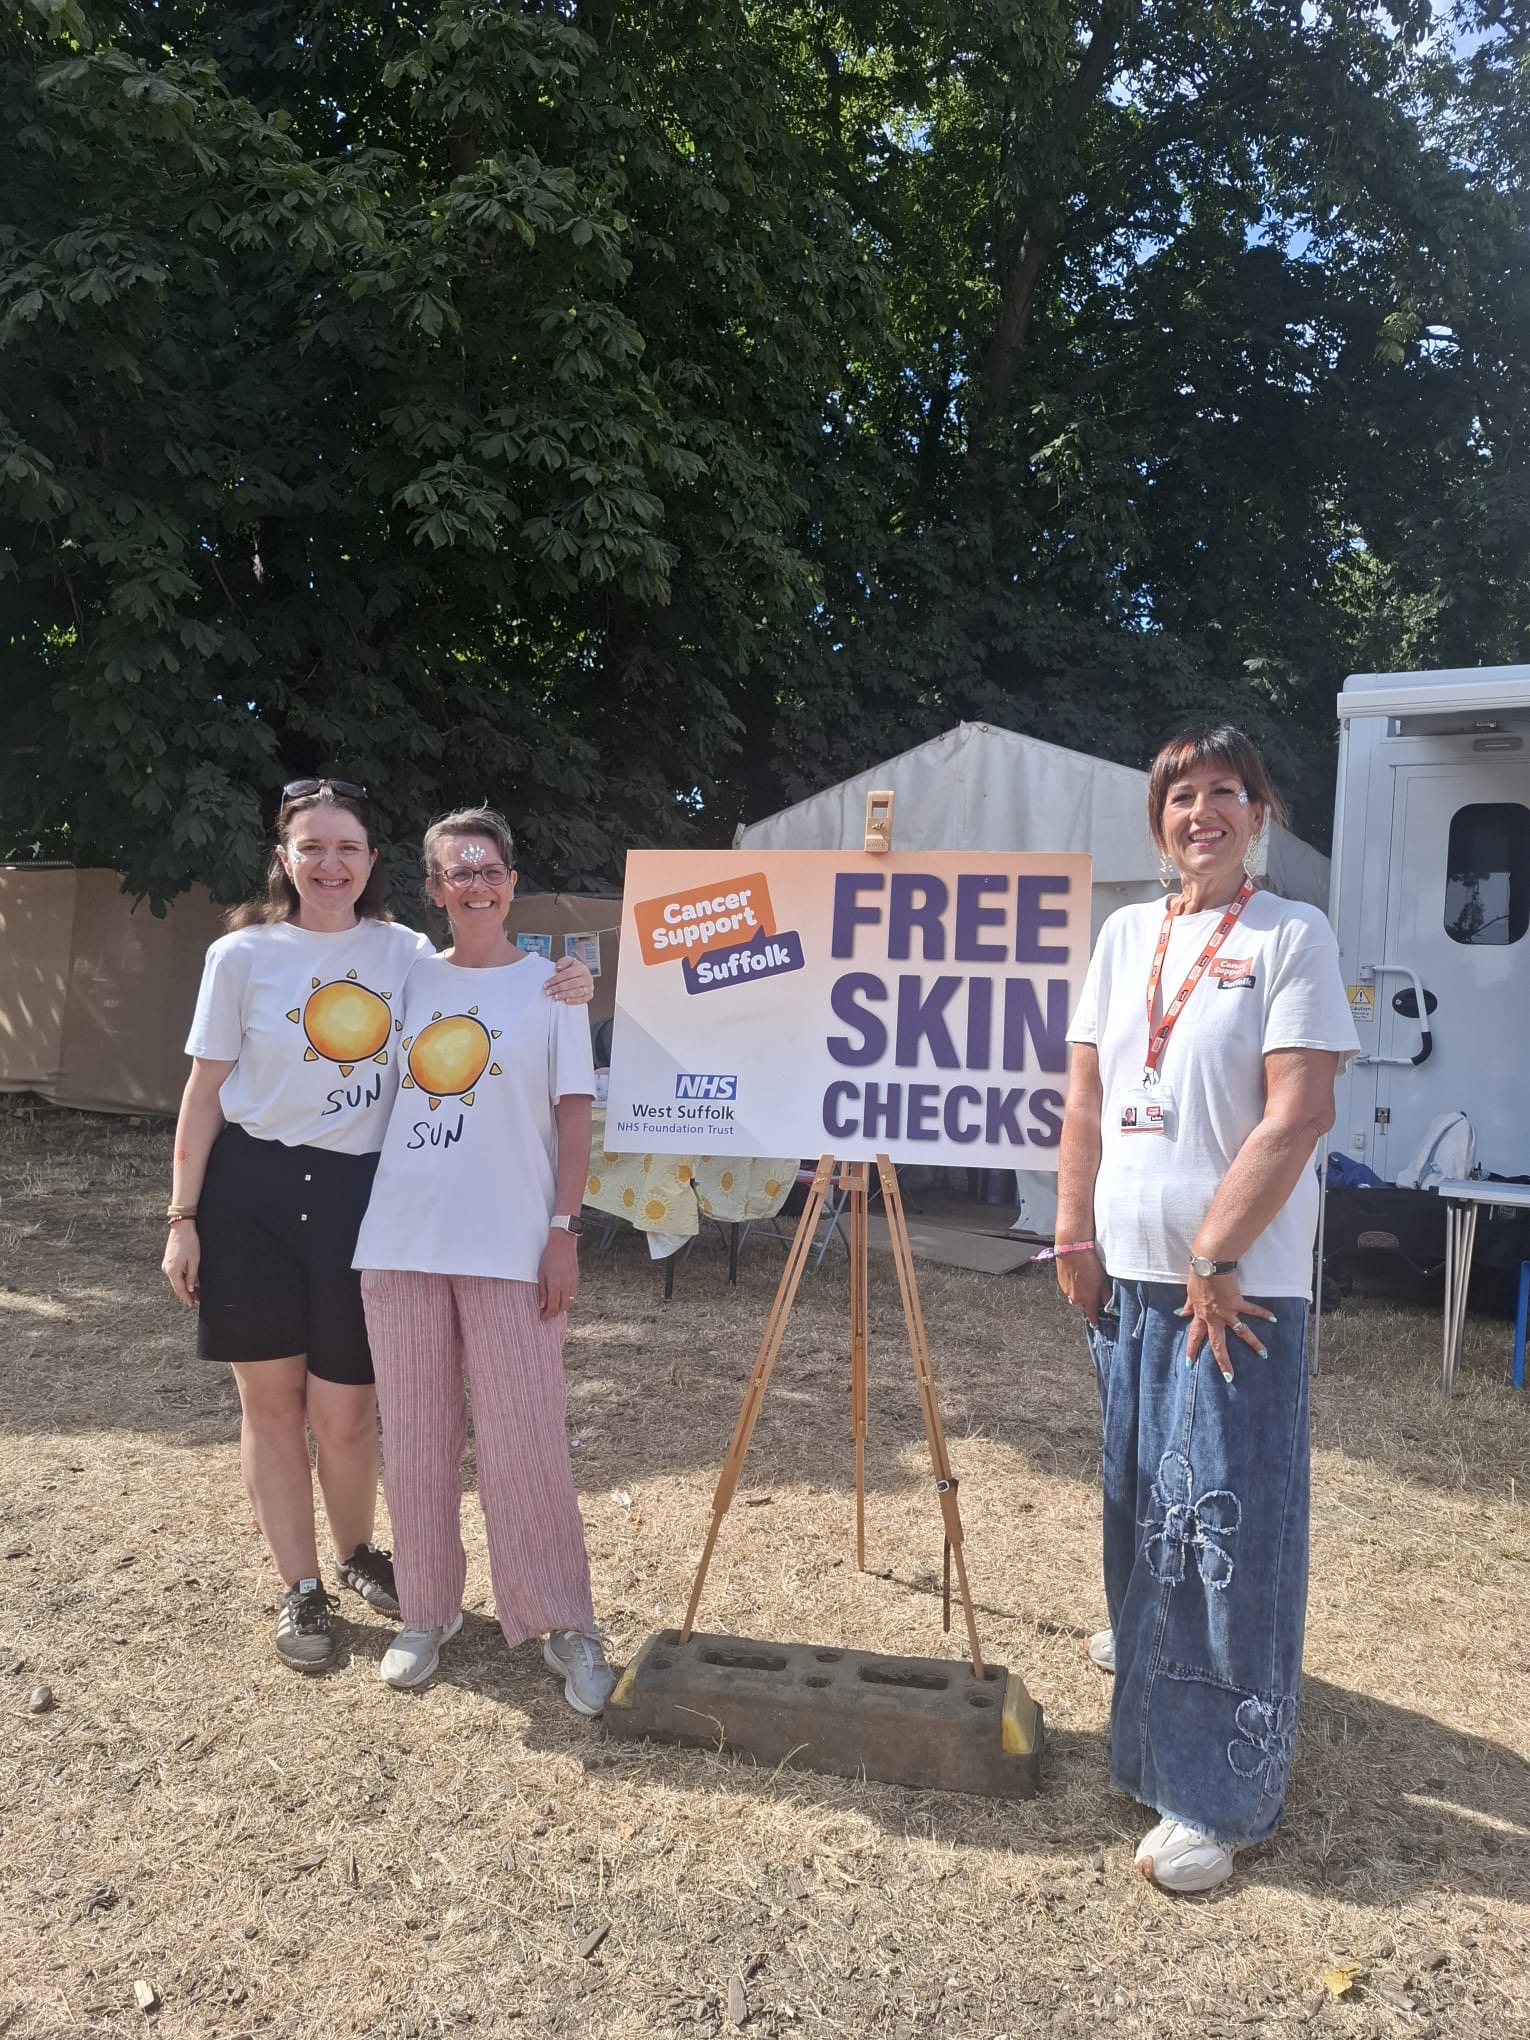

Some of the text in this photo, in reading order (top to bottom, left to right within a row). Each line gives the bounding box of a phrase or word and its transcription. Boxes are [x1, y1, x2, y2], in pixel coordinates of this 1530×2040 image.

[663, 889, 752, 924] Cancer
[831, 872, 1070, 964] FREE
[652, 906, 757, 949] Support
[696, 943, 791, 984] Suffolk
[826, 971, 1069, 1073] SKIN
[320, 1072, 382, 1116] SUN
[677, 1075, 736, 1099] NHS
[406, 1113, 464, 1150] SUN
[617, 1121, 734, 1135] NHS Foundation Trust
[632, 1103, 735, 1120] West Suffolk
[823, 1080, 1065, 1148] CHECKS
